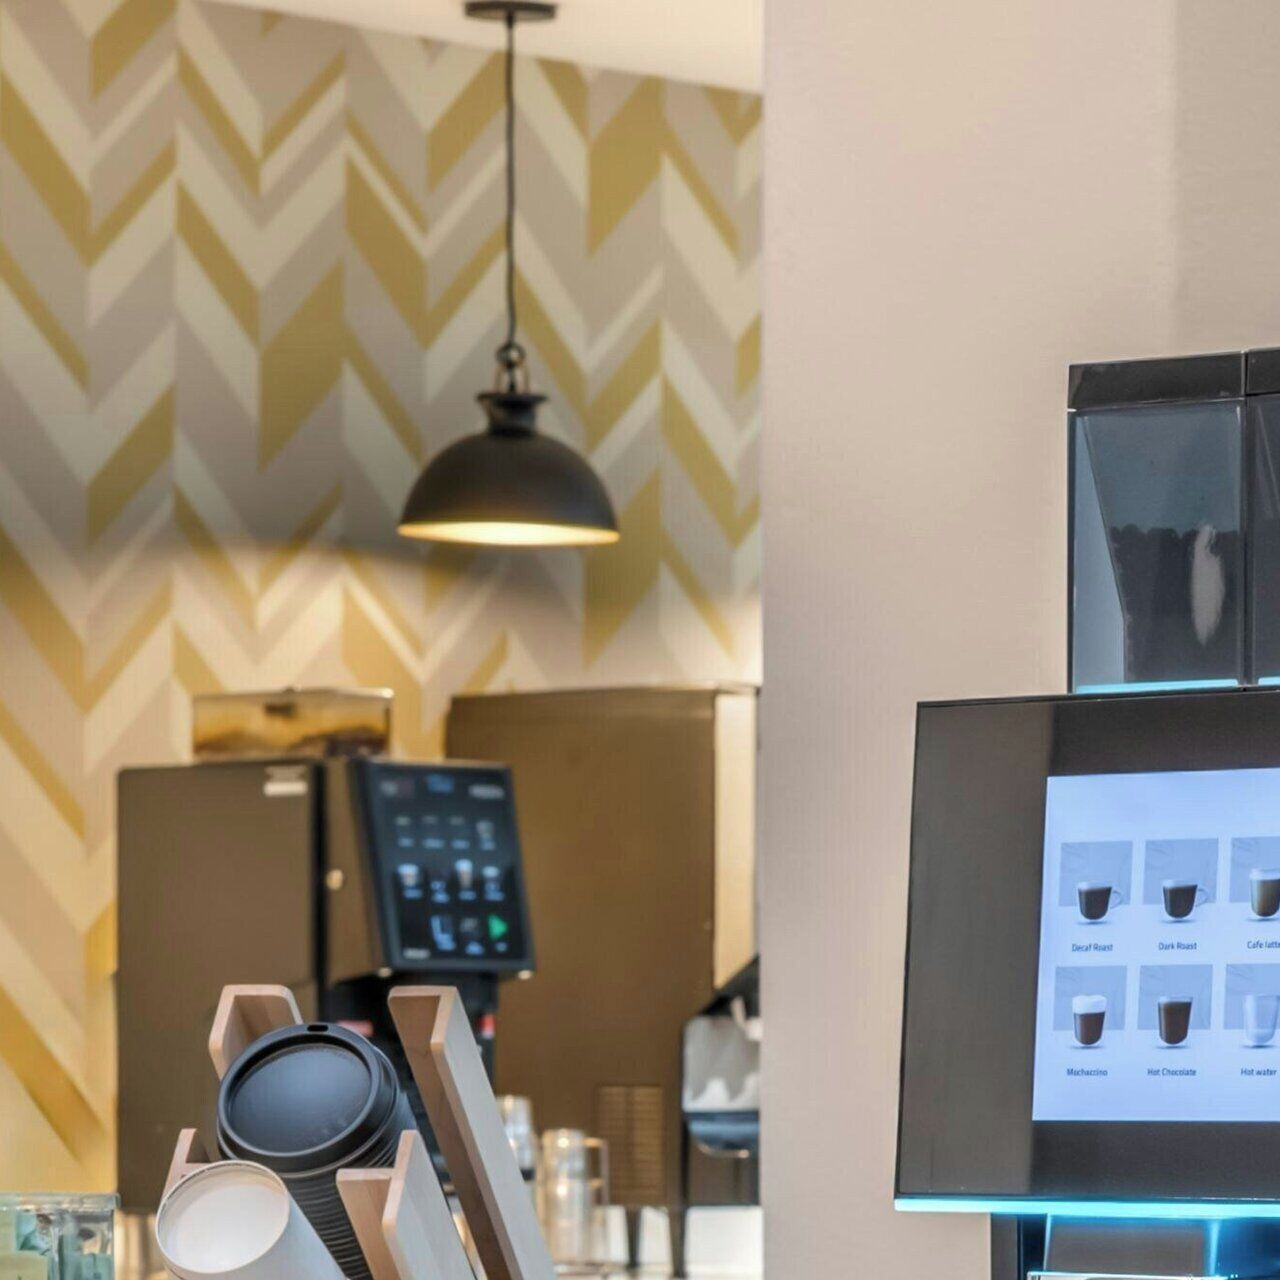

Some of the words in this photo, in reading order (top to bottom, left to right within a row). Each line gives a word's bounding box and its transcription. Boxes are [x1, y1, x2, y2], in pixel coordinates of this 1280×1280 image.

[1071, 943, 1093, 952] Decaf
[1093, 942, 1114, 952] Roast
[1158, 942, 1175, 951] Dark
[1176, 941, 1197, 950] Roast
[1246, 940, 1264, 950] Cafe
[1066, 1067, 1108, 1077] Mochaccino
[1147, 1067, 1161, 1076] Hot
[1162, 1067, 1197, 1076] Chocolate
[1240, 1067, 1255, 1076] Hot
[1256, 1068, 1277, 1077] water
